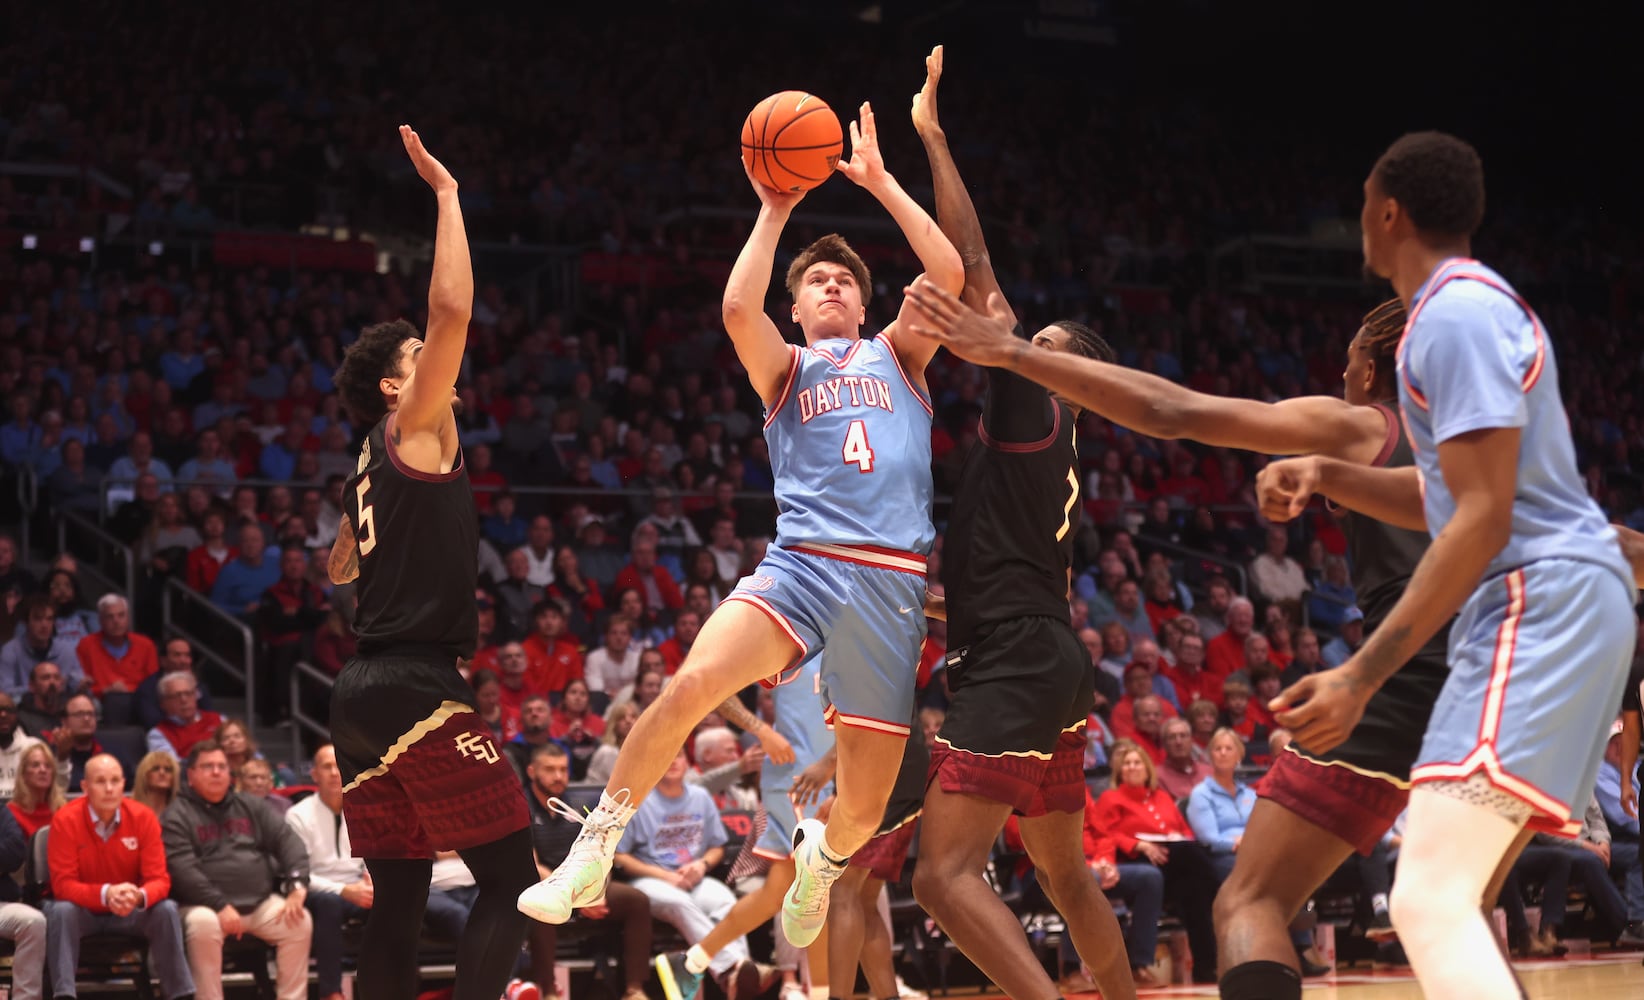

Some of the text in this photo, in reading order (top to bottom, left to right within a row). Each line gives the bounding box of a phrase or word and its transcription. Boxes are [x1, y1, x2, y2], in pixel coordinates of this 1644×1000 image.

[798, 376, 894, 424] DAYTON
[842, 420, 875, 473] 4
[355, 472, 377, 558] 5
[453, 729, 501, 765] FSU
